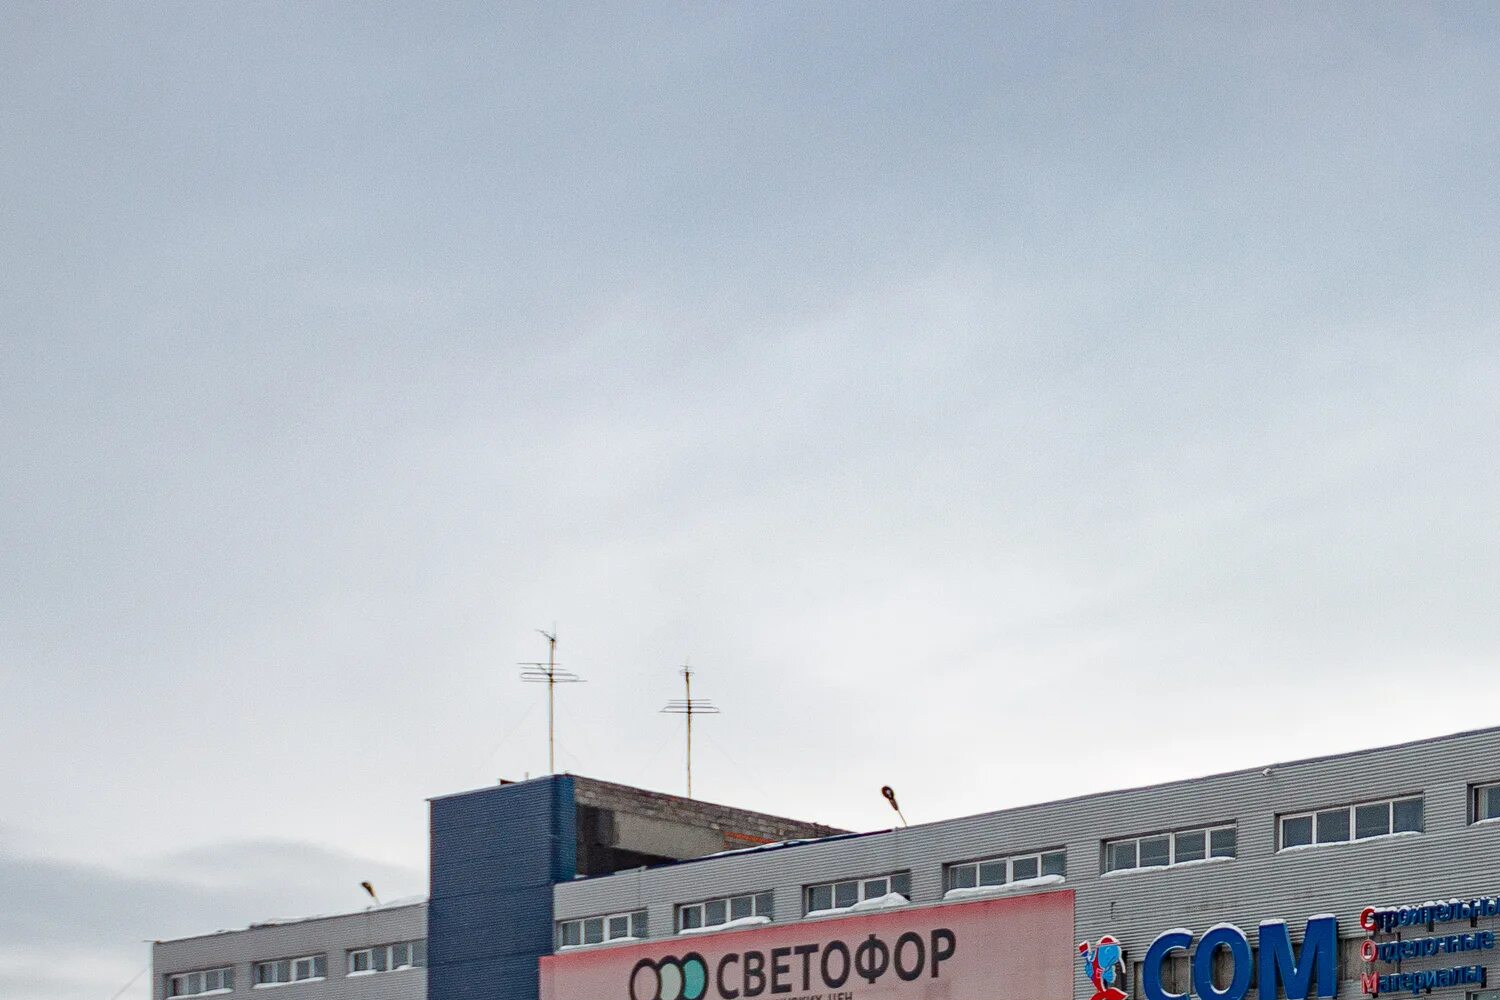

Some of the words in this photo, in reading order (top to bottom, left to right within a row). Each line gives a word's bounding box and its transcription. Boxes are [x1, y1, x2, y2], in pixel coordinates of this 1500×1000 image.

[1360, 930, 1496, 963] Отделочные
[716, 928, 956, 1000] СВЕТОФОР
[1360, 965, 1484, 994] Материалы
